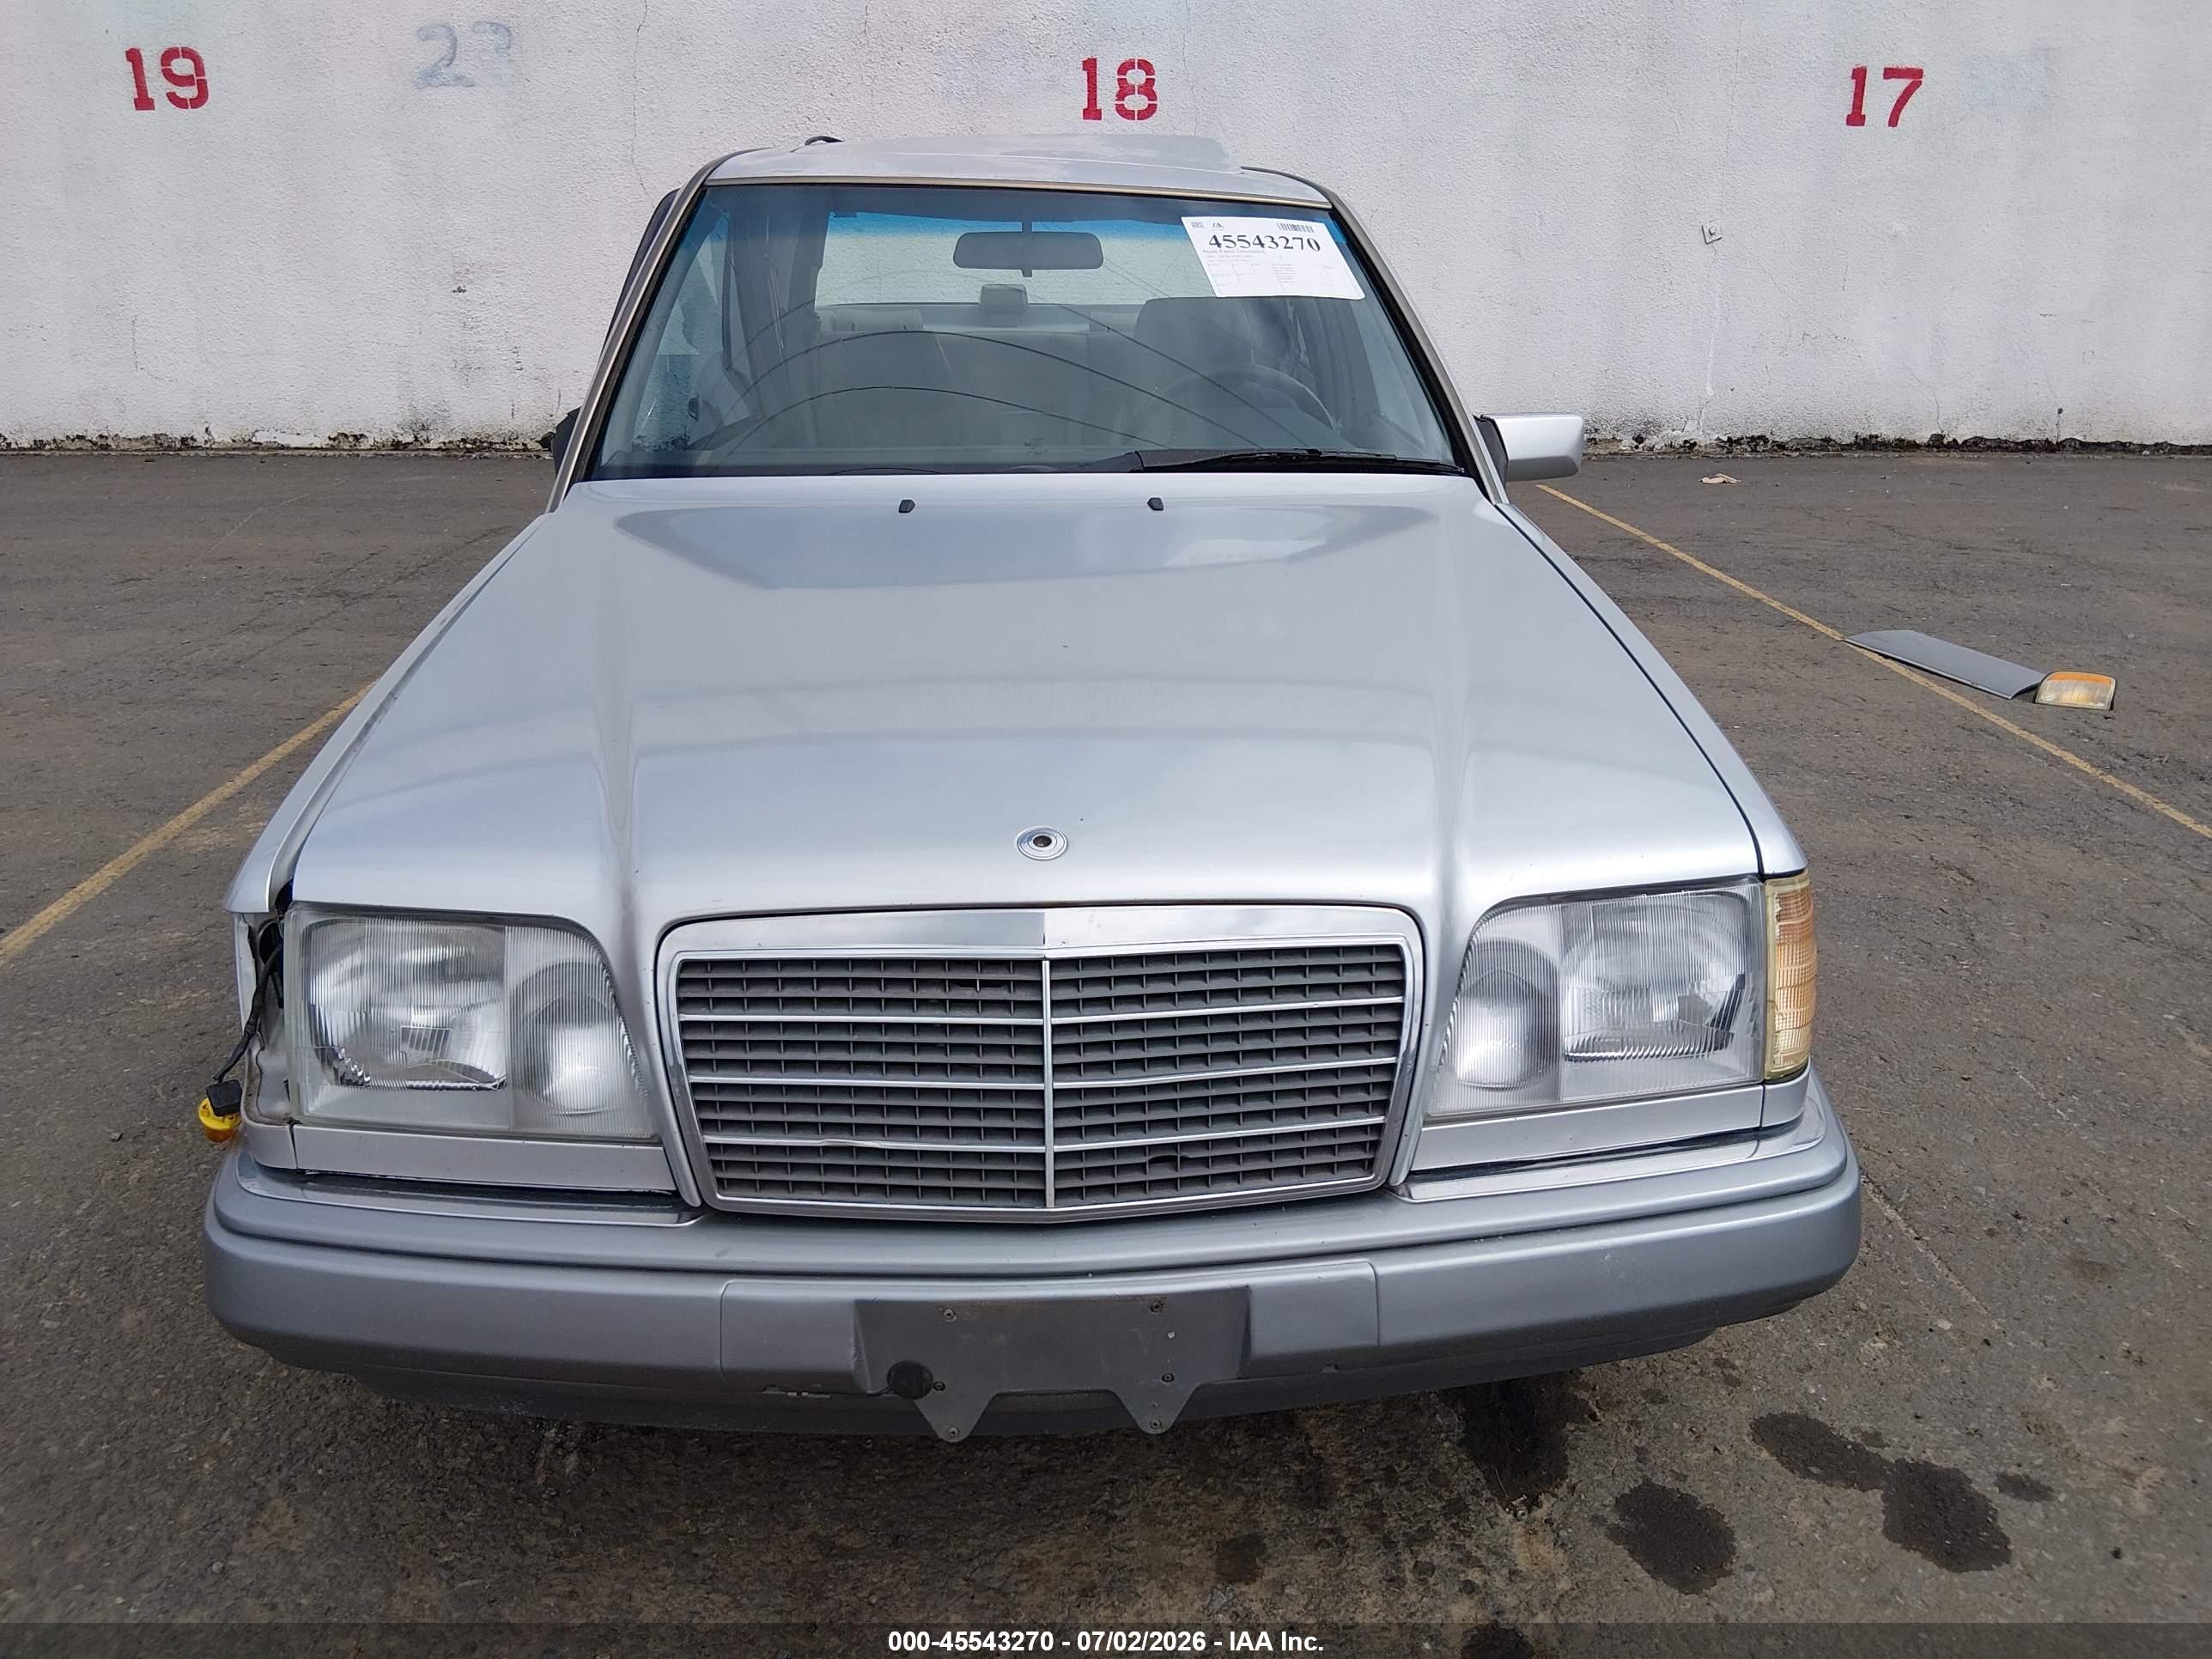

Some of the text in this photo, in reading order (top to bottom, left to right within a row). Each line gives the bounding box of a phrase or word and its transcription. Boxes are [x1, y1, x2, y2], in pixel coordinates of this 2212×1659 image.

[125, 46, 210, 111] 19
[1082, 58, 1158, 121] 18
[1845, 66, 1924, 128] 17
[1208, 234, 1321, 252] 45543270
